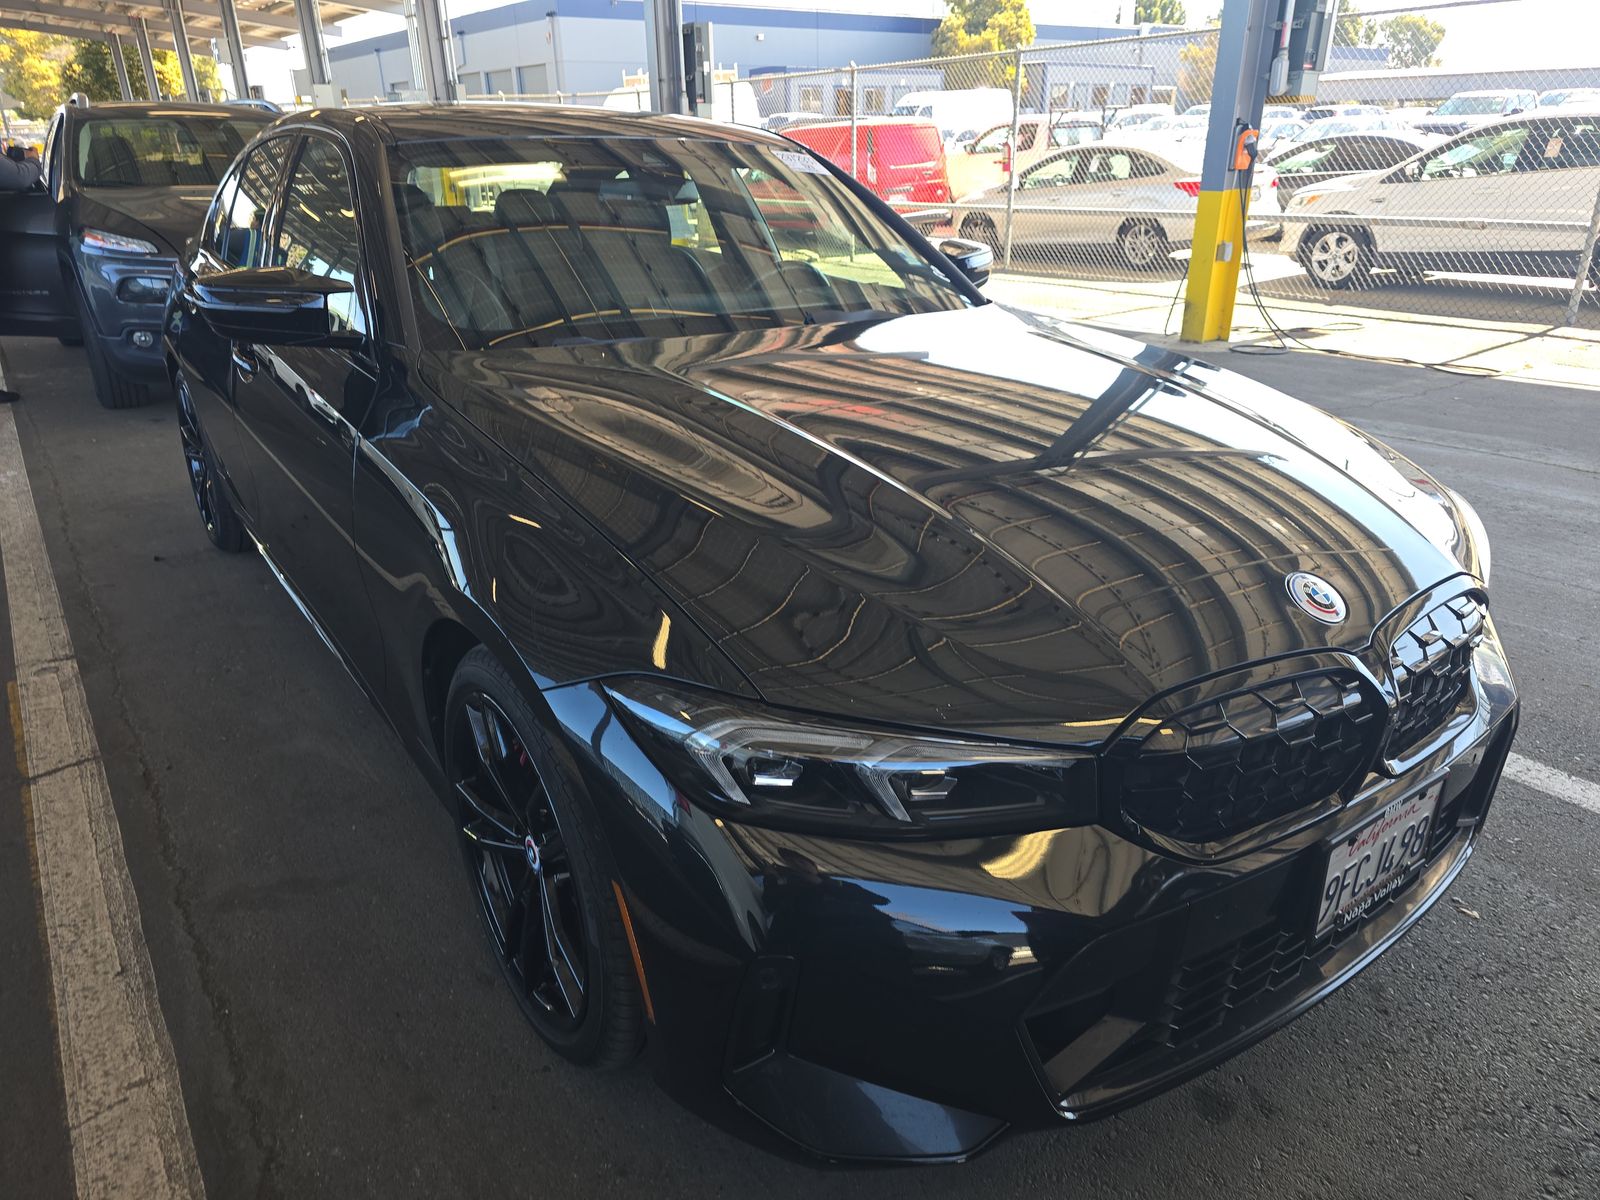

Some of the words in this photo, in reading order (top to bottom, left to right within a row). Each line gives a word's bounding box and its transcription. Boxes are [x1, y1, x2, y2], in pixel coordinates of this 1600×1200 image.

[1348, 803, 1422, 858] California
[1318, 815, 1430, 924] 9FCJ498
[1344, 903, 1371, 925] Napa
[1373, 874, 1405, 902] Valley
